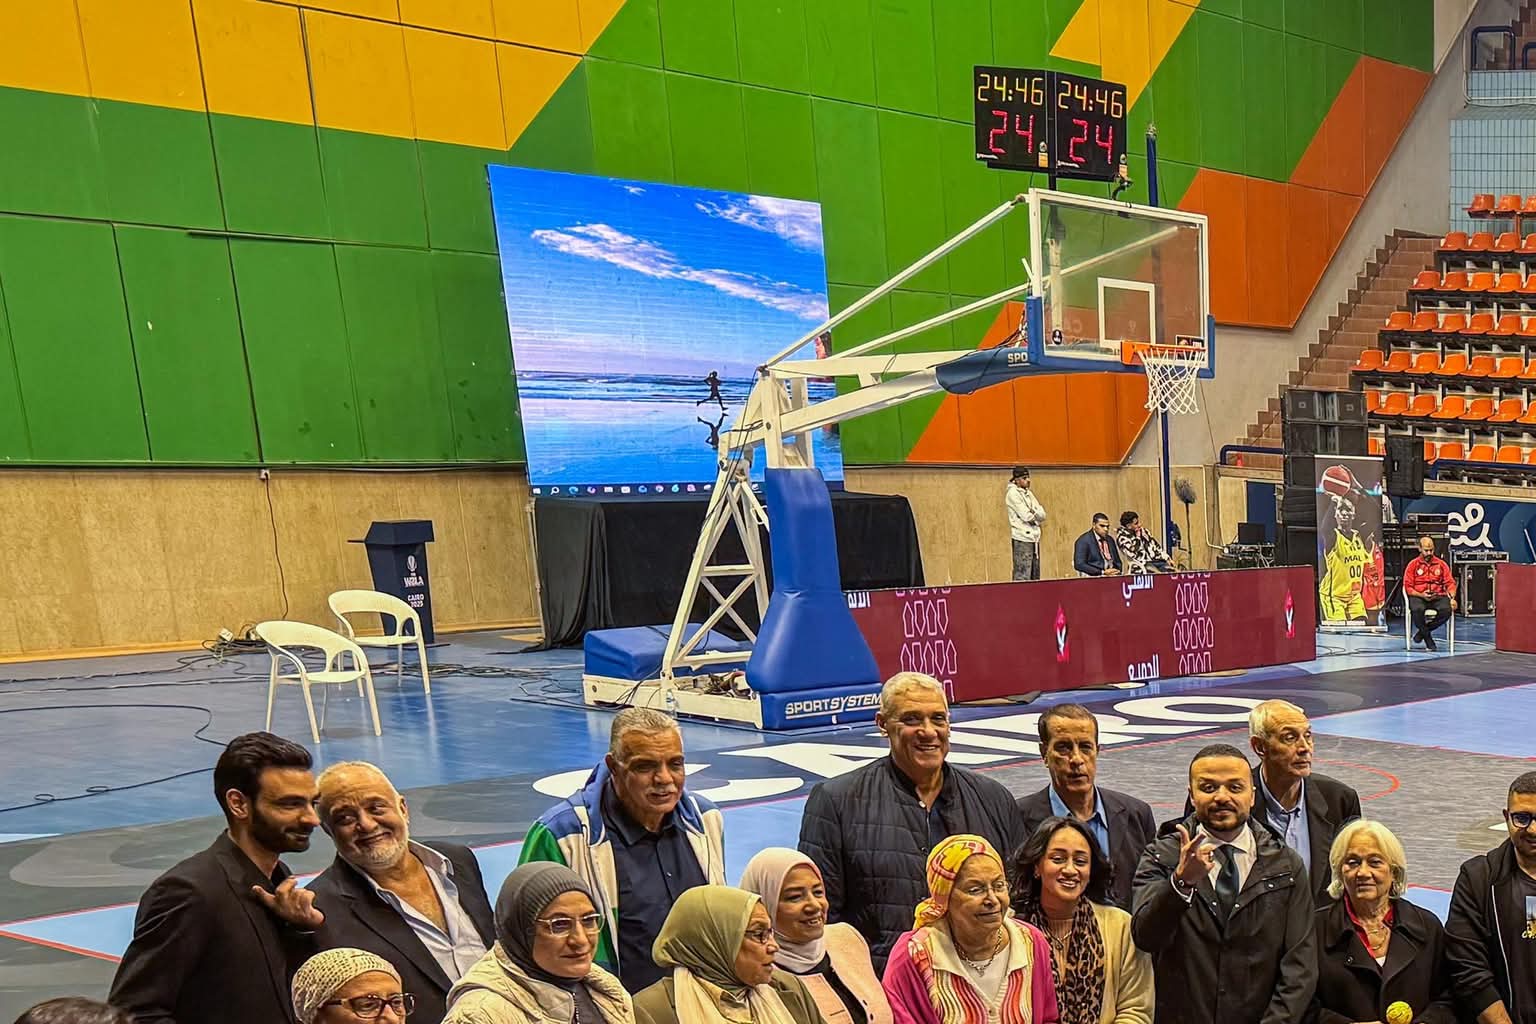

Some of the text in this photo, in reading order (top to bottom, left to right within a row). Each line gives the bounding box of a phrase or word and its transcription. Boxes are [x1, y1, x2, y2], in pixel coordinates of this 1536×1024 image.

[977, 73, 1044, 106] 24:46
[1058, 81, 1124, 119] 24:46
[989, 110, 1034, 154] 24
[1069, 118, 1113, 164] 24
[1007, 352, 1028, 364] SPO
[1349, 565, 1362, 578] 00
